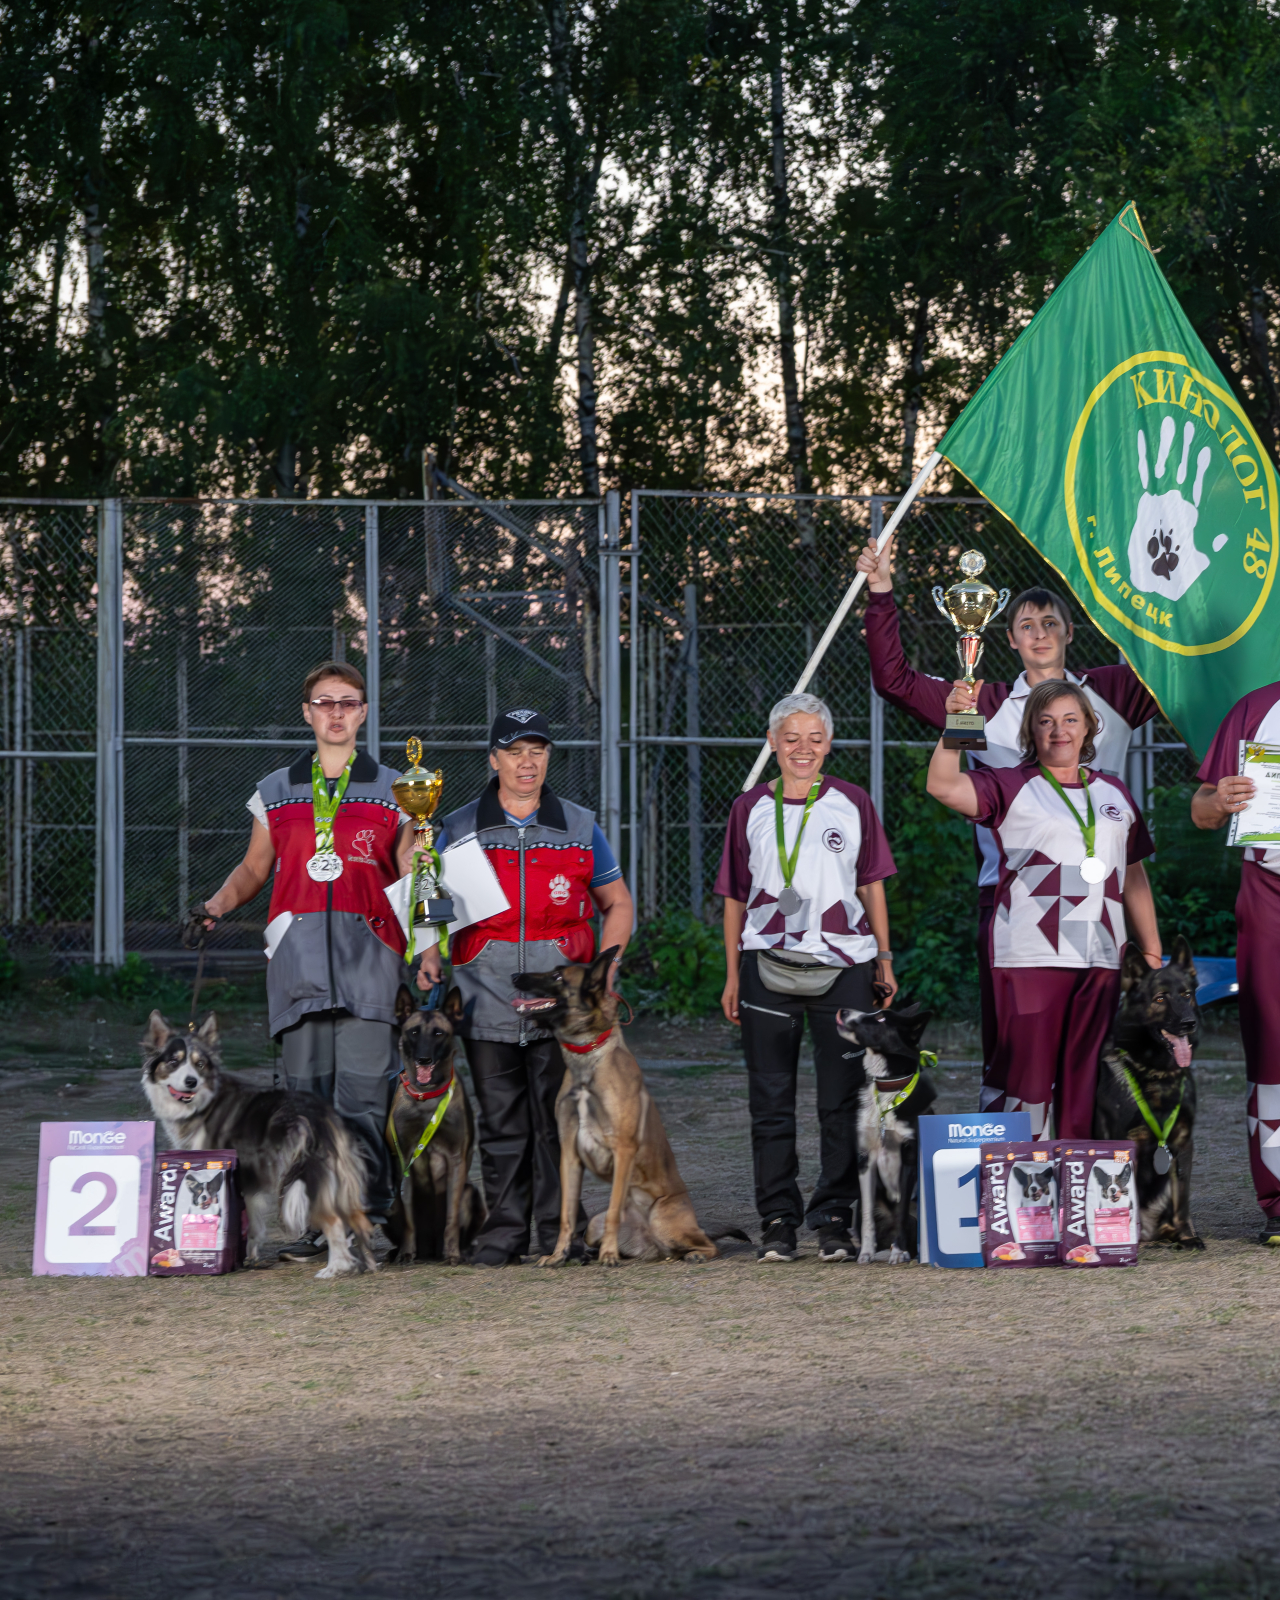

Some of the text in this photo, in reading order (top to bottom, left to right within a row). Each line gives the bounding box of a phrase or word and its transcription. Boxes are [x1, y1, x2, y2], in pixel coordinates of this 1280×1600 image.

[1093, 545, 1174, 627] Липецк
[1242, 527, 1271, 580] 48
[68, 1171, 118, 1237] 2
[153, 1168, 178, 1242] Award
[957, 1163, 981, 1228] 1
[985, 1161, 1010, 1235] Award
[1065, 1160, 1087, 1238] Award
